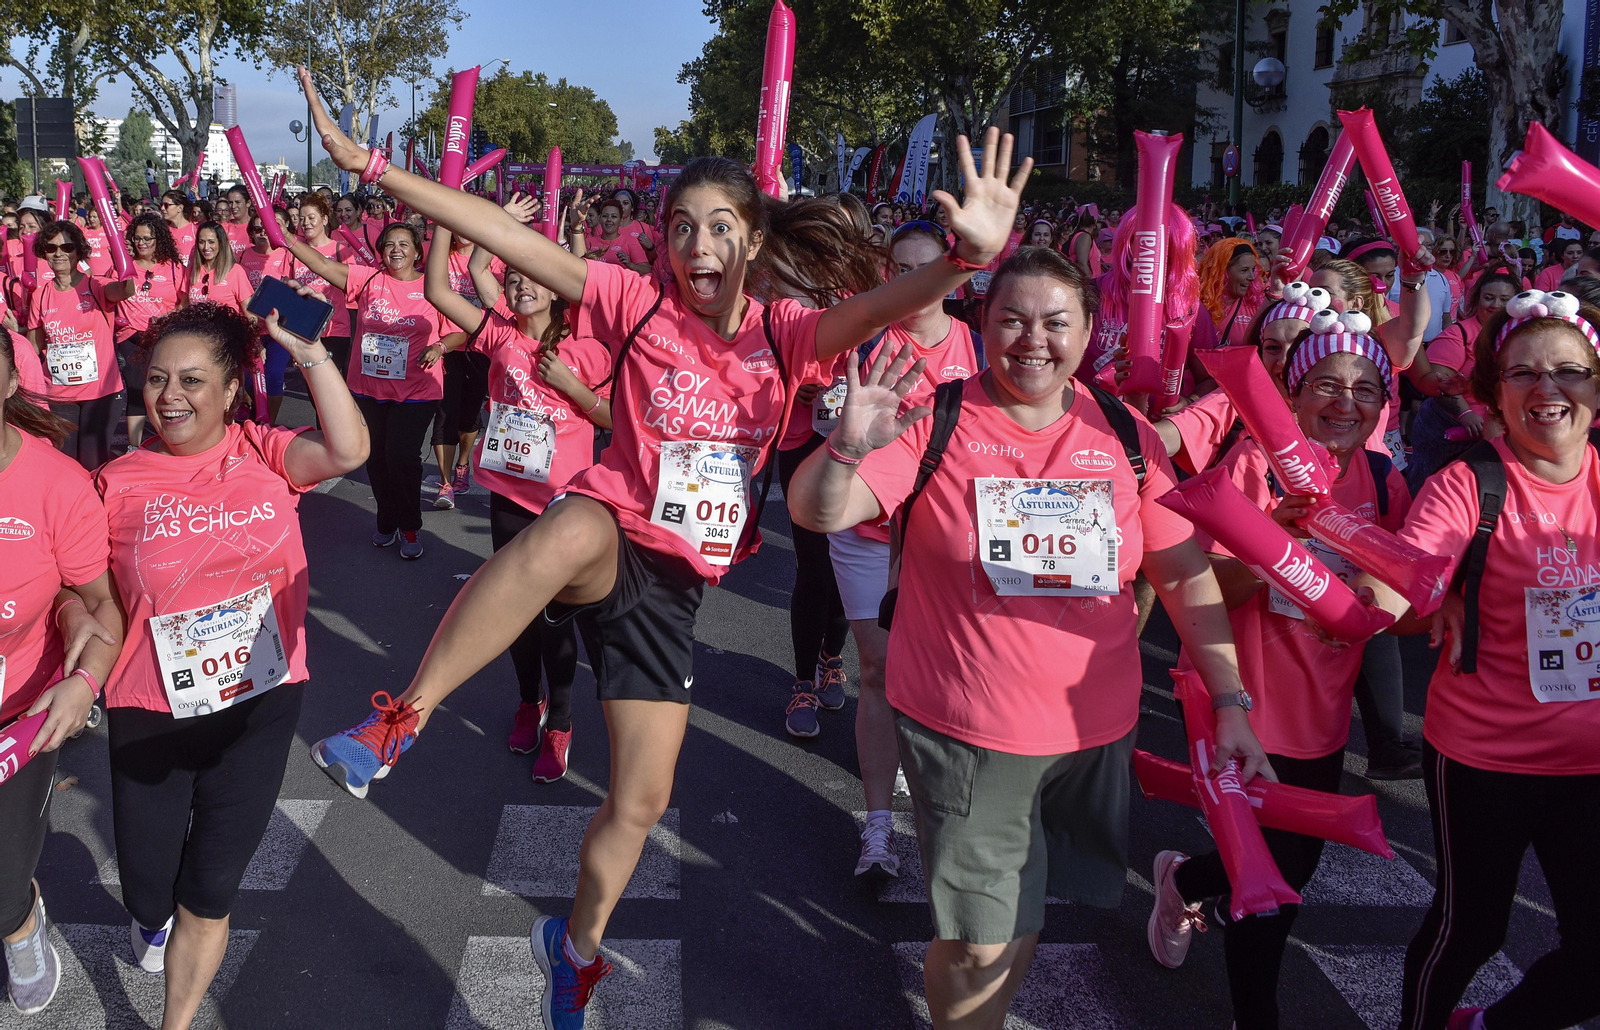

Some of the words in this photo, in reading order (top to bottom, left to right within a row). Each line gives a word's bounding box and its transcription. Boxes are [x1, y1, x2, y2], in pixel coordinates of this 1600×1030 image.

[447, 116, 468, 155] Ladival
[904, 140, 918, 186] ZURICH
[918, 139, 929, 185] ZURICH
[1375, 177, 1407, 223] Ladival
[359, 246, 376, 264] Ladival
[1132, 230, 1157, 294] Ladival
[372, 298, 391, 306] HOY
[368, 305, 400, 316] GANAN
[45, 321, 61, 330] HOY
[365, 312, 380, 321] LAS
[381, 315, 416, 326] CHICAS
[62, 330, 93, 341] CHICAS
[62, 362, 82, 371] 016
[373, 354, 392, 364] 016
[506, 364, 532, 383] HOY
[658, 366, 710, 395] HOY
[1163, 368, 1180, 396] Ladival
[520, 398, 567, 421] CHICAS
[650, 387, 738, 423] GANAN
[508, 416, 536, 430] ASTURIANA
[643, 406, 685, 435] LAS
[504, 438, 531, 455] 016
[968, 441, 1024, 459] OYSHO
[508, 453, 522, 462] 3044
[1074, 456, 1114, 468] ASTURIANA
[700, 461, 746, 477] ASTURIAN
[143, 493, 188, 513] HOY
[1017, 497, 1075, 509] ASTURIANA
[144, 502, 224, 525] GANAN
[696, 500, 740, 524] 016
[142, 519, 181, 542] LAS
[188, 501, 275, 534] CHICAS
[1059, 516, 1085, 525] Carrera
[1313, 505, 1374, 541] Ladival
[0, 528, 31, 536] TURIANA
[705, 527, 729, 539] 3043
[710, 545, 730, 553] Santander
[1022, 533, 1077, 555] 016
[1536, 545, 1577, 565] HOY
[1041, 560, 1056, 570] 78
[1272, 541, 1330, 601] Ladival
[251, 572, 267, 583] City
[268, 567, 285, 578] Map
[1536, 563, 1600, 587] GANA
[1080, 599, 1095, 613] City
[1271, 595, 1295, 608] YSHO
[193, 616, 244, 638] ASTURIANA
[232, 628, 256, 640] Carrera
[201, 646, 251, 677] 016
[217, 670, 243, 686] 6695
[264, 673, 282, 685] ZURICH
[229, 683, 250, 695] Santander
[1540, 684, 1576, 692] OYSHO
[178, 698, 209, 710] OYSHO
